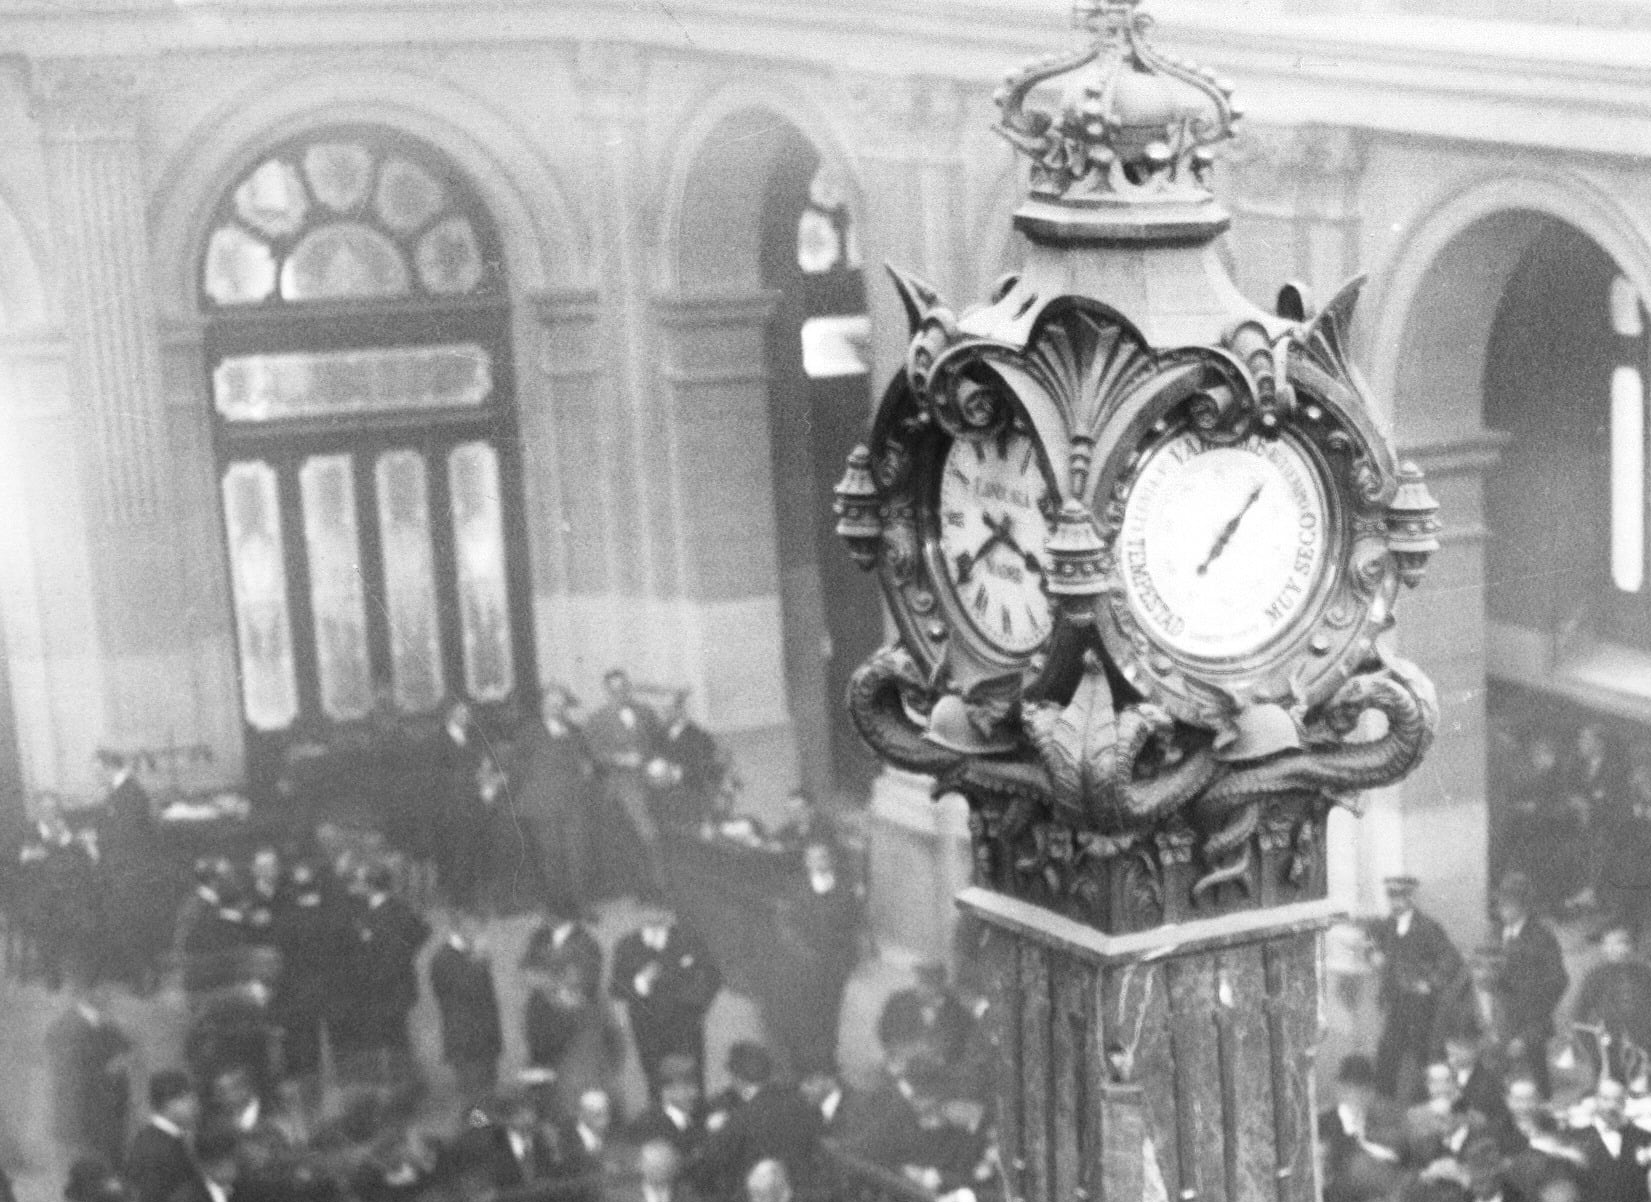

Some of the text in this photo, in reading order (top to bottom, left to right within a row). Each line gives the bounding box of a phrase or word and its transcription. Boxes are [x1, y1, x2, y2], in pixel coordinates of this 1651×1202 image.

[1127, 537, 1186, 637] TEMPESTAD
[1264, 511, 1317, 627] MUY SECO
